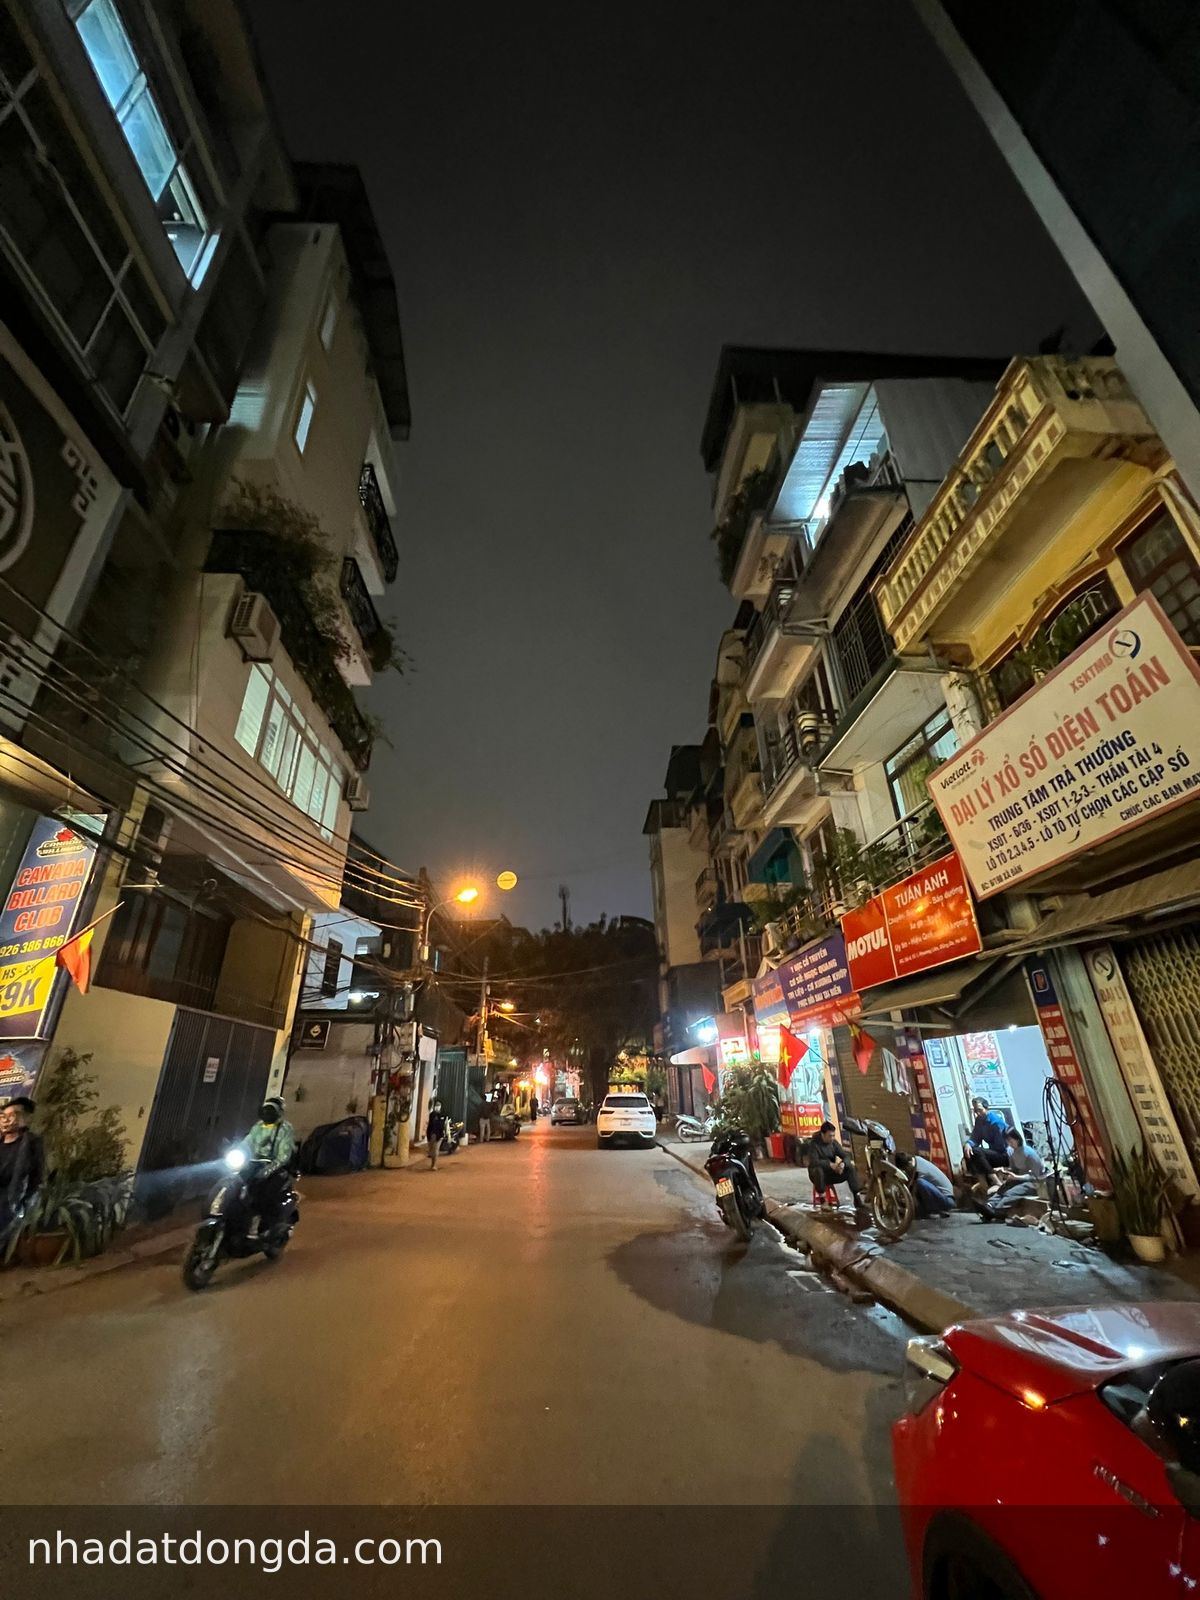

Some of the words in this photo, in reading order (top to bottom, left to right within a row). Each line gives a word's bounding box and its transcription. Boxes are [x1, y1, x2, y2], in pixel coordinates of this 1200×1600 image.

[950, 794, 978, 827] ĐẠI
[974, 776, 996, 811] LÝ
[993, 753, 1021, 797] XỔ
[1019, 735, 1048, 778] SỐ
[1044, 706, 1101, 761] ĐIỆN
[1095, 655, 1171, 722] TOÁN
[987, 802, 1024, 832] TRUNG
[1021, 787, 1050, 811] TÂM
[1048, 764, 1077, 794] TRẢ
[1074, 729, 1137, 778] THƯỞNG
[1012, 818, 1032, 839] 6/36
[1095, 760, 1129, 789] THẦN
[1127, 747, 1152, 770] TÀI
[1151, 742, 1164, 756] 4
[1080, 791, 1113, 820] CHỌN
[1112, 779, 1139, 806] CÁC
[1138, 763, 1165, 788] CẶP
[1167, 744, 1190, 772] SỐ
[17, 858, 86, 887] CANADA
[924, 869, 949, 895] ANH
[7, 881, 82, 911] BILLARD
[14, 906, 64, 933] CLUB
[20, 939, 43, 954] 386
[847, 927, 888, 962] MOTUL
[2, 967, 17, 980] HS
